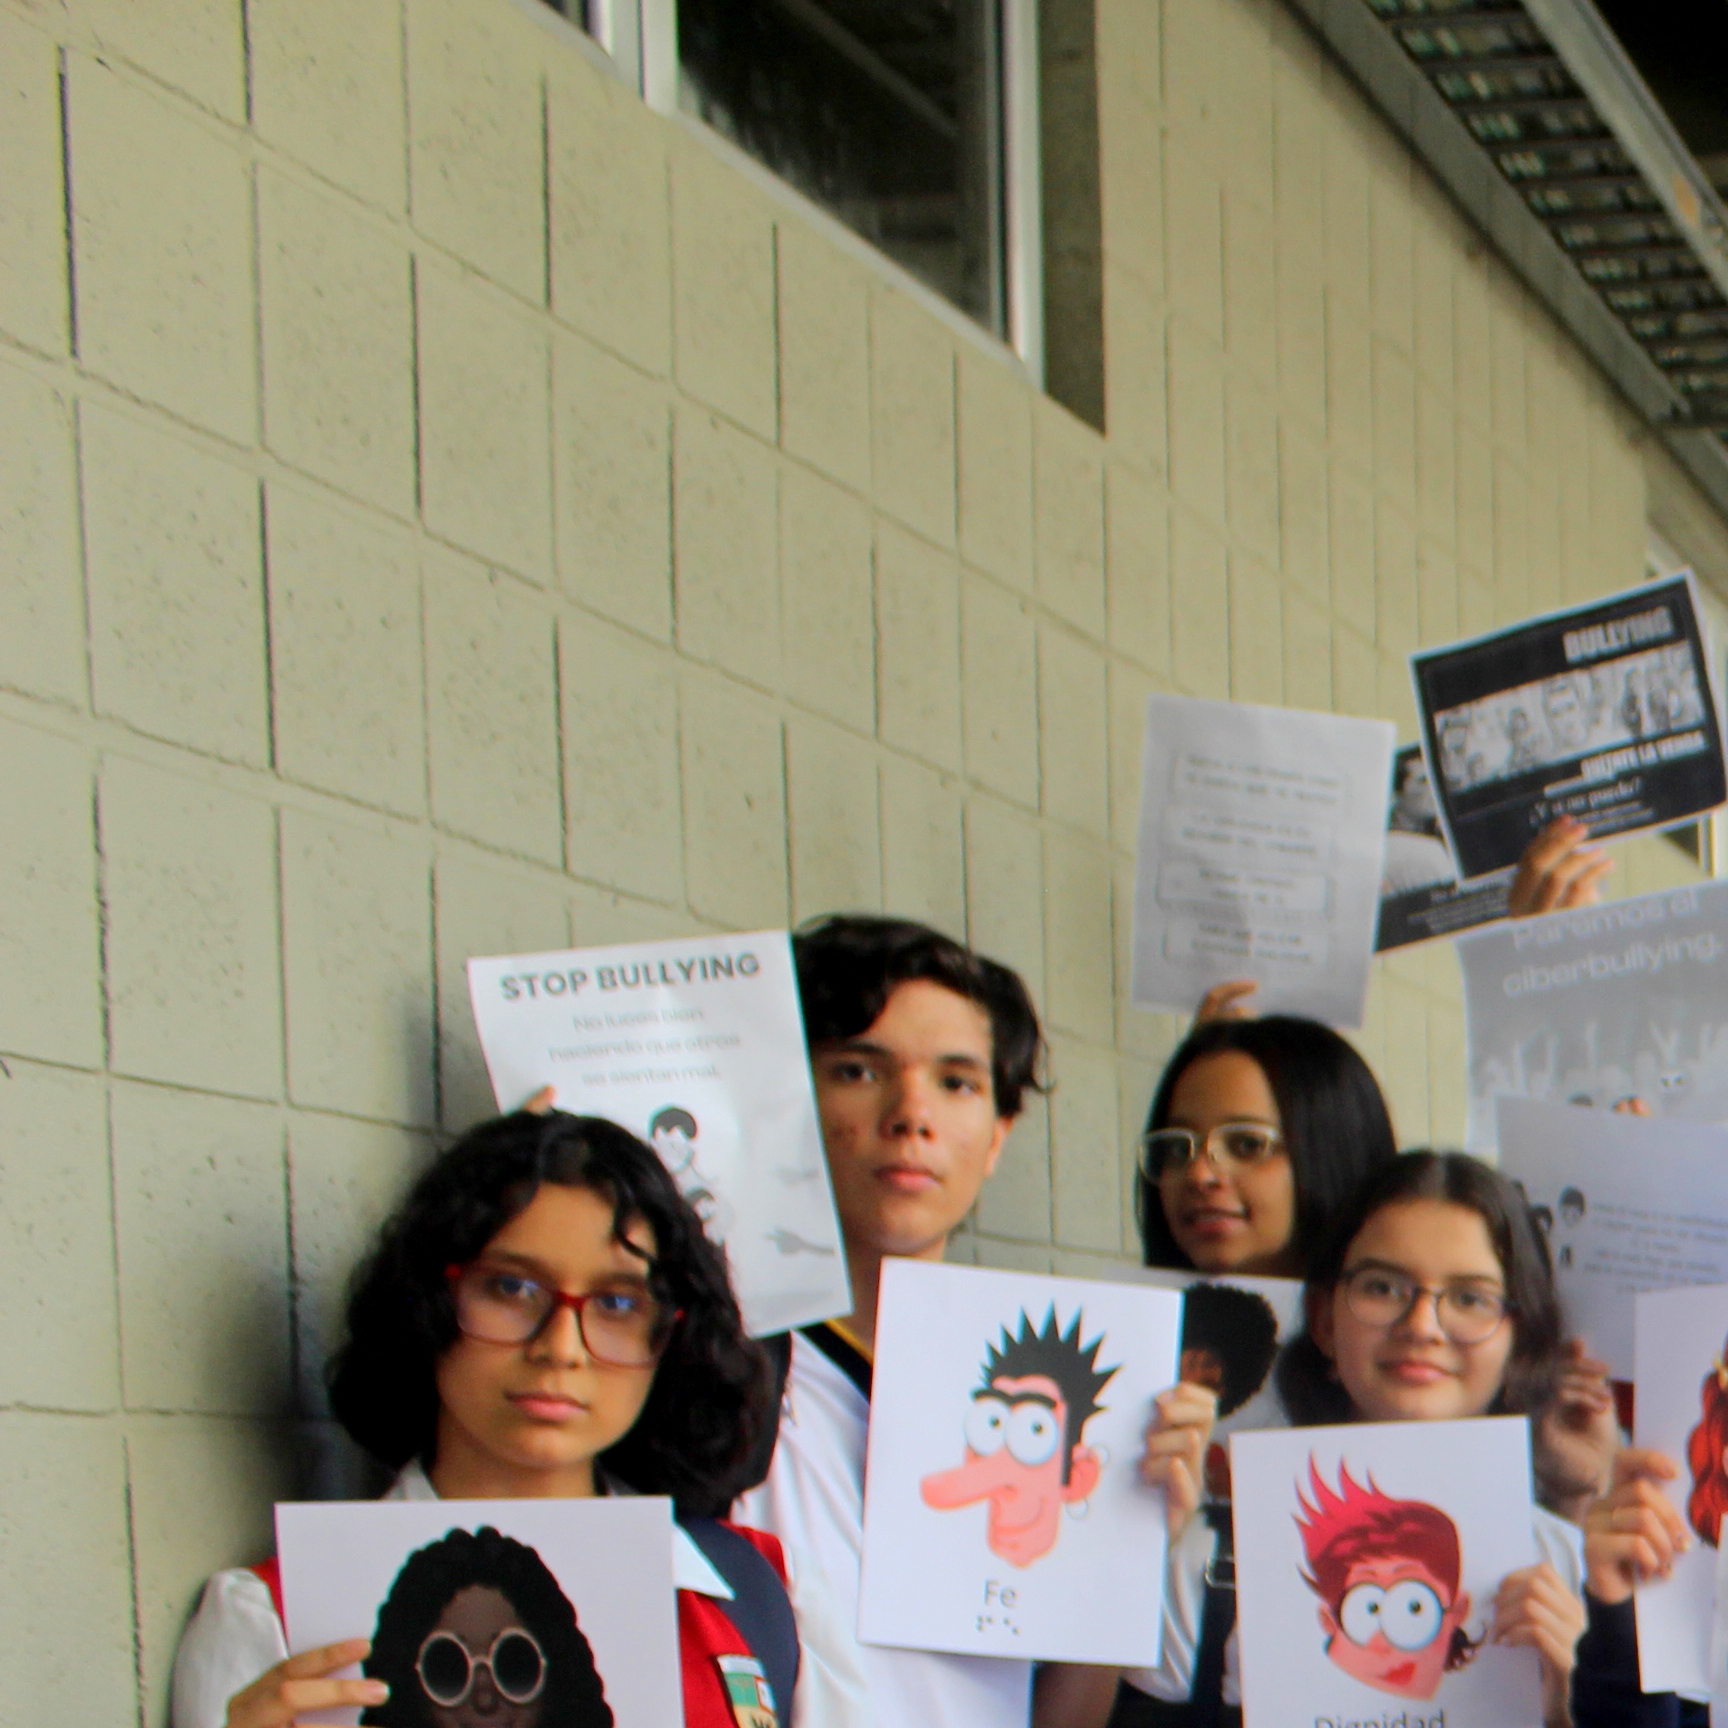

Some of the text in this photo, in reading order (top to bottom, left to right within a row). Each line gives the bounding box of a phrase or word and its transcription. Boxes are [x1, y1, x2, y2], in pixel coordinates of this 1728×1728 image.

[500, 952, 762, 1001] STOP BULLYING
[984, 1578, 1019, 1608] Fe
